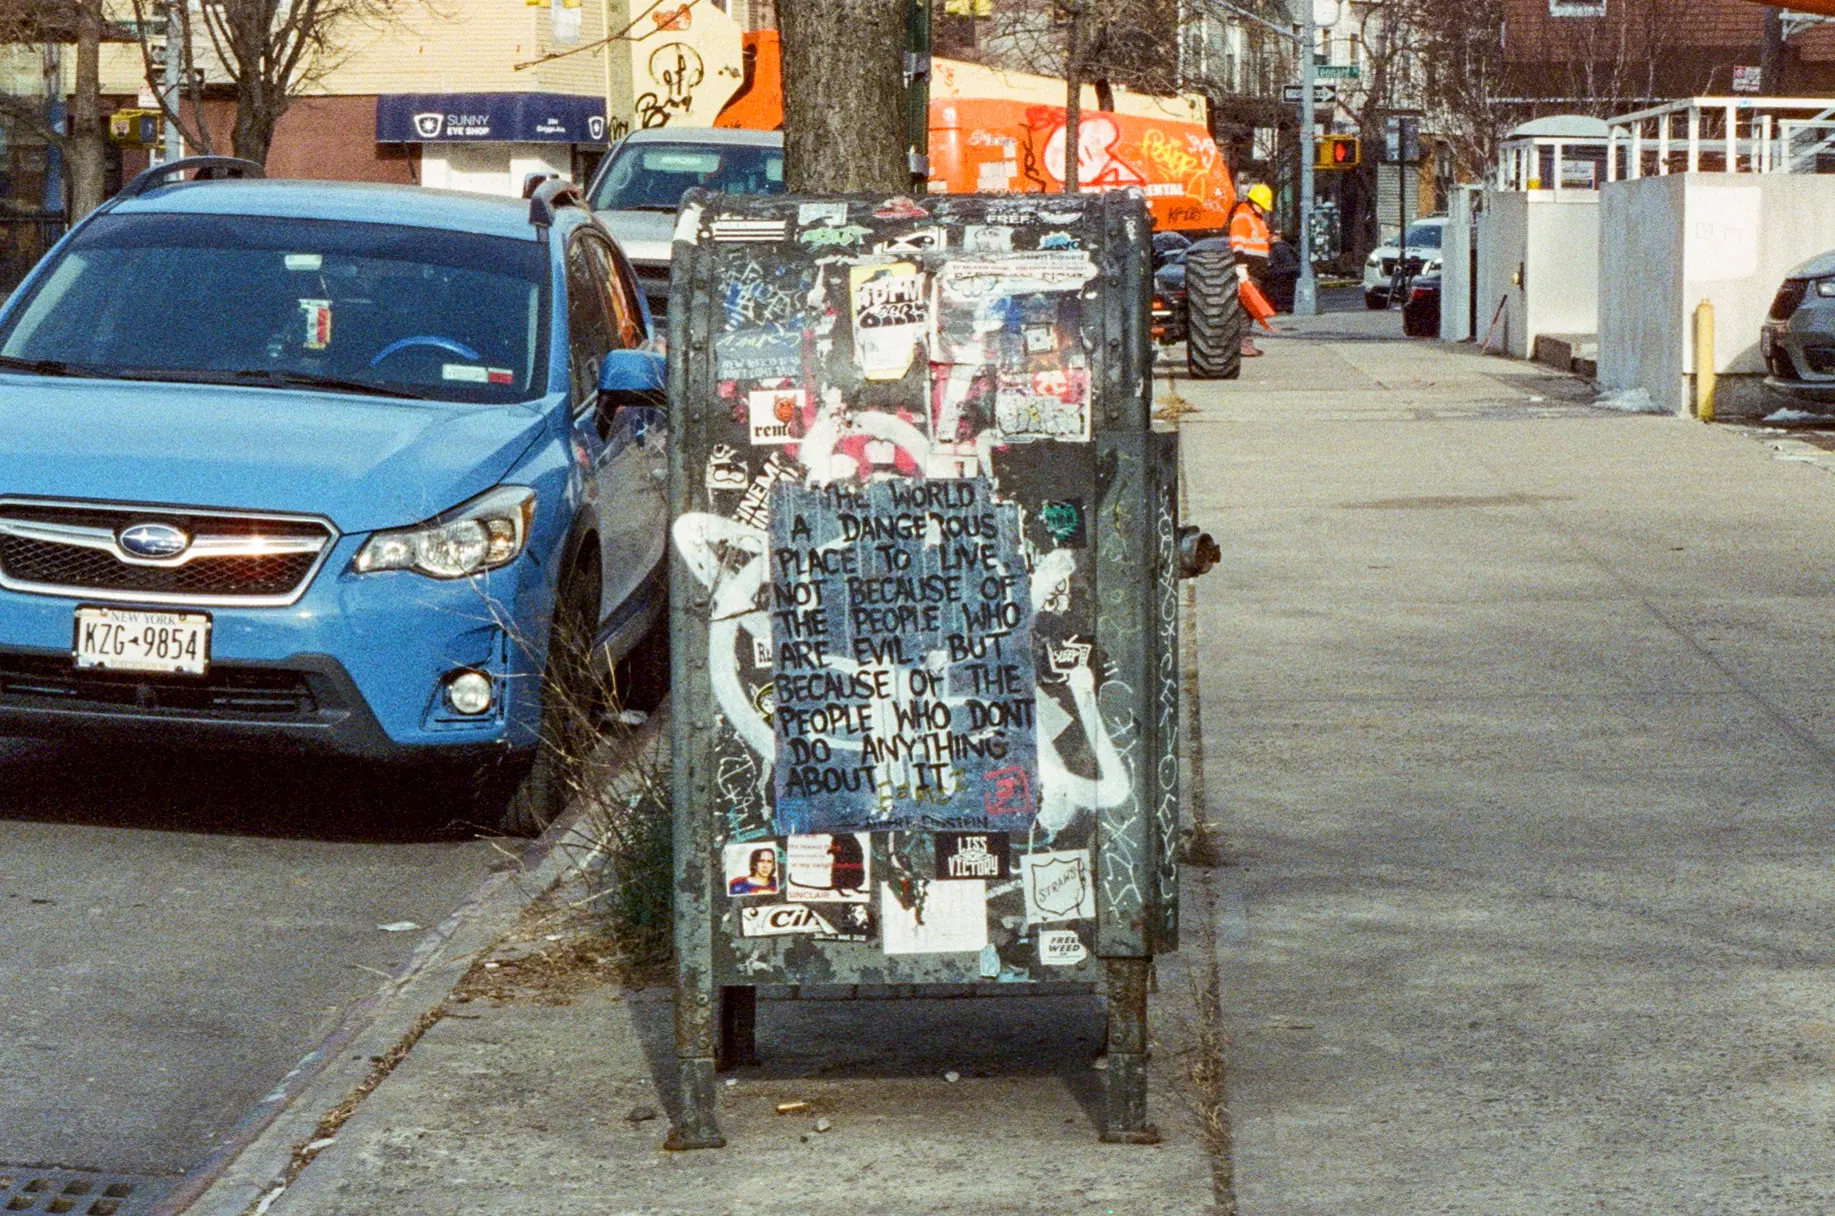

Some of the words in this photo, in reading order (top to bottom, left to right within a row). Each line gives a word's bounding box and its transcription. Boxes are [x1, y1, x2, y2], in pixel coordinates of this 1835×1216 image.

[446, 114, 490, 126] SUNNY
[446, 127, 464, 136] EYE
[465, 127, 490, 136] SHOP
[1145, 183, 1185, 196] ENTAL
[824, 481, 871, 509] THE
[887, 481, 976, 509] WORLD
[792, 513, 811, 543] A
[836, 512, 998, 543] DANGEROUS
[774, 549, 857, 578] PLACE
[875, 543, 911, 574] TO
[771, 579, 828, 608] NOT
[846, 575, 962, 604] BECAUSE
[980, 574, 1016, 601] OF
[111, 614, 140, 623] NEW
[143, 615, 177, 626] YORK
[773, 609, 828, 638] THE
[851, 605, 941, 635] PEOPLE
[962, 601, 1021, 633] WHO
[85, 622, 125, 655] KZG
[144, 626, 198, 660] 9854
[778, 641, 832, 670] ARE
[947, 632, 1012, 663] BUT
[774, 670, 890, 702] BECAUSE
[909, 668, 944, 697] OF
[965, 664, 1022, 697] THE
[776, 704, 873, 736] PEOPLE
[893, 700, 951, 731] WHO
[964, 699, 1036, 730] DONT
[788, 737, 832, 766] DO
[861, 731, 1010, 765] ANYTHING
[786, 765, 878, 798] ABOUT
[913, 762, 950, 794] IT
[948, 855, 999, 876] VICTORY
[1038, 866, 1077, 903] STRAWS
[1048, 944, 1080, 952] WEED
